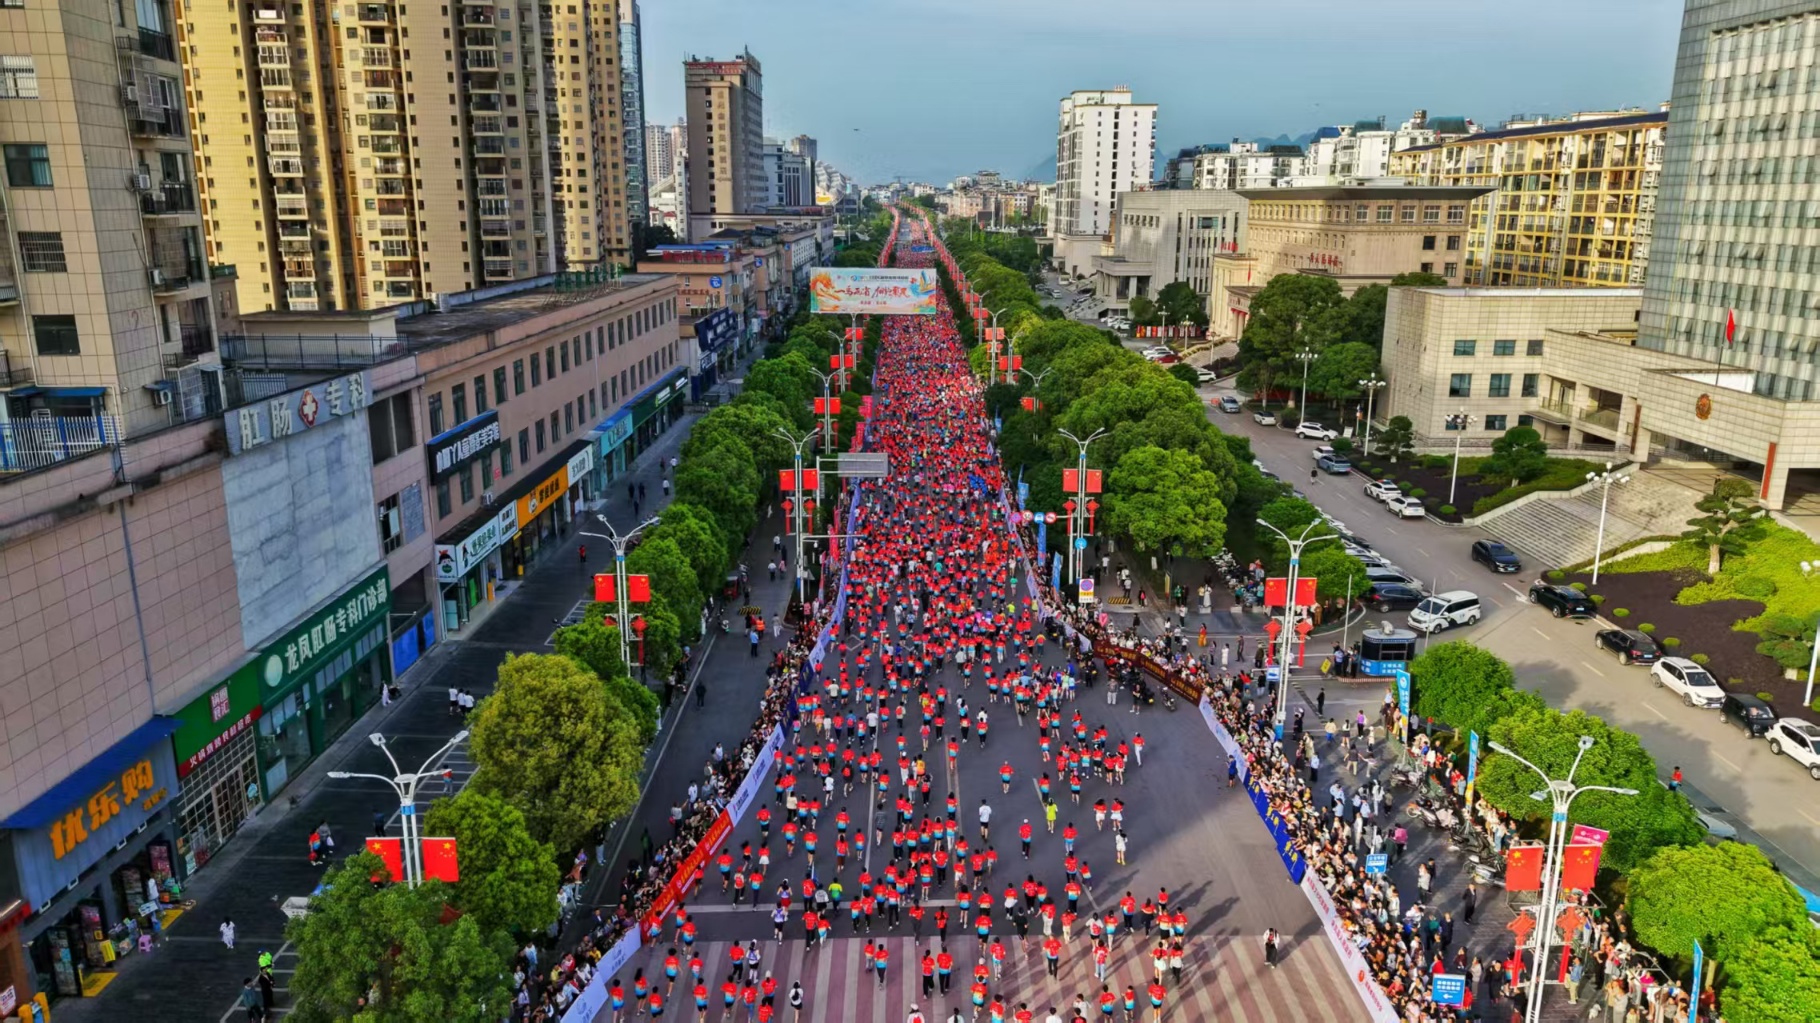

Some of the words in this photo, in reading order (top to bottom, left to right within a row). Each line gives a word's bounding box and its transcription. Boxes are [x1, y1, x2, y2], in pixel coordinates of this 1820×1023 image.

[239, 396, 292, 450] 肛肠
[325, 372, 367, 417] 专科
[285, 578, 387, 674] 龙凤肛肠专科门诊部
[50, 759, 154, 860] 优乐购
